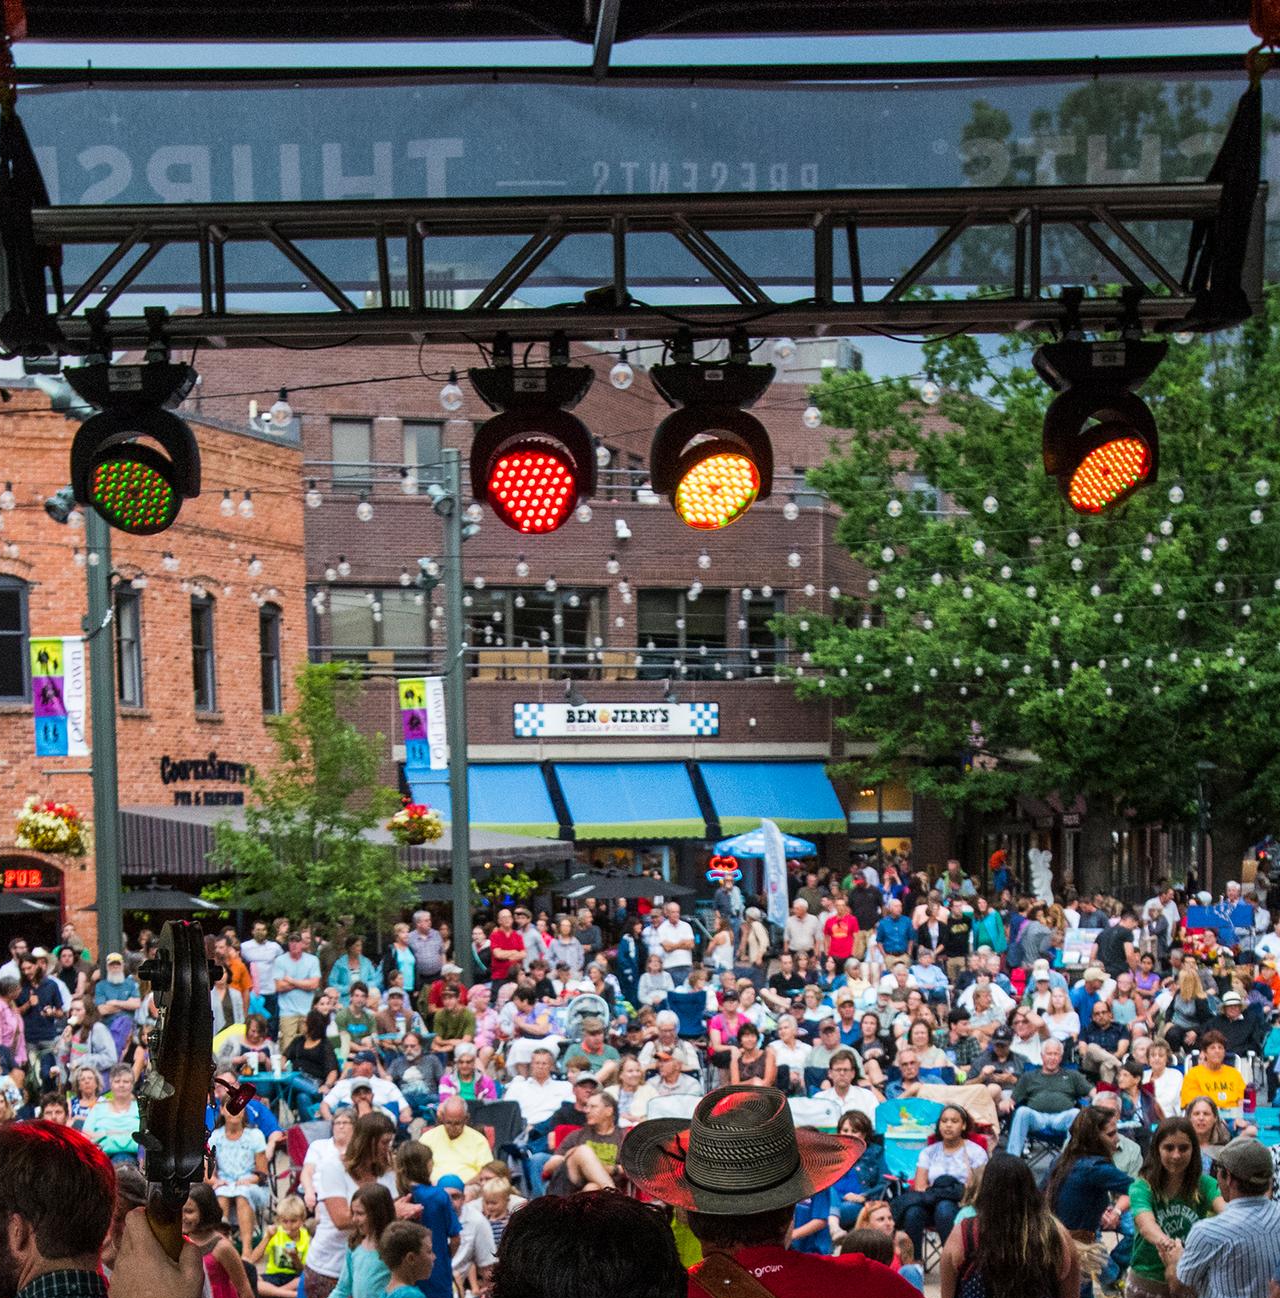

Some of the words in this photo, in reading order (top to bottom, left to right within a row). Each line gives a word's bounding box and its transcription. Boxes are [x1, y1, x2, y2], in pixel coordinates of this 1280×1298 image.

[566, 709, 597, 724] BEN
[611, 708, 670, 724] JERRY'S
[4, 869, 43, 888] PUB
